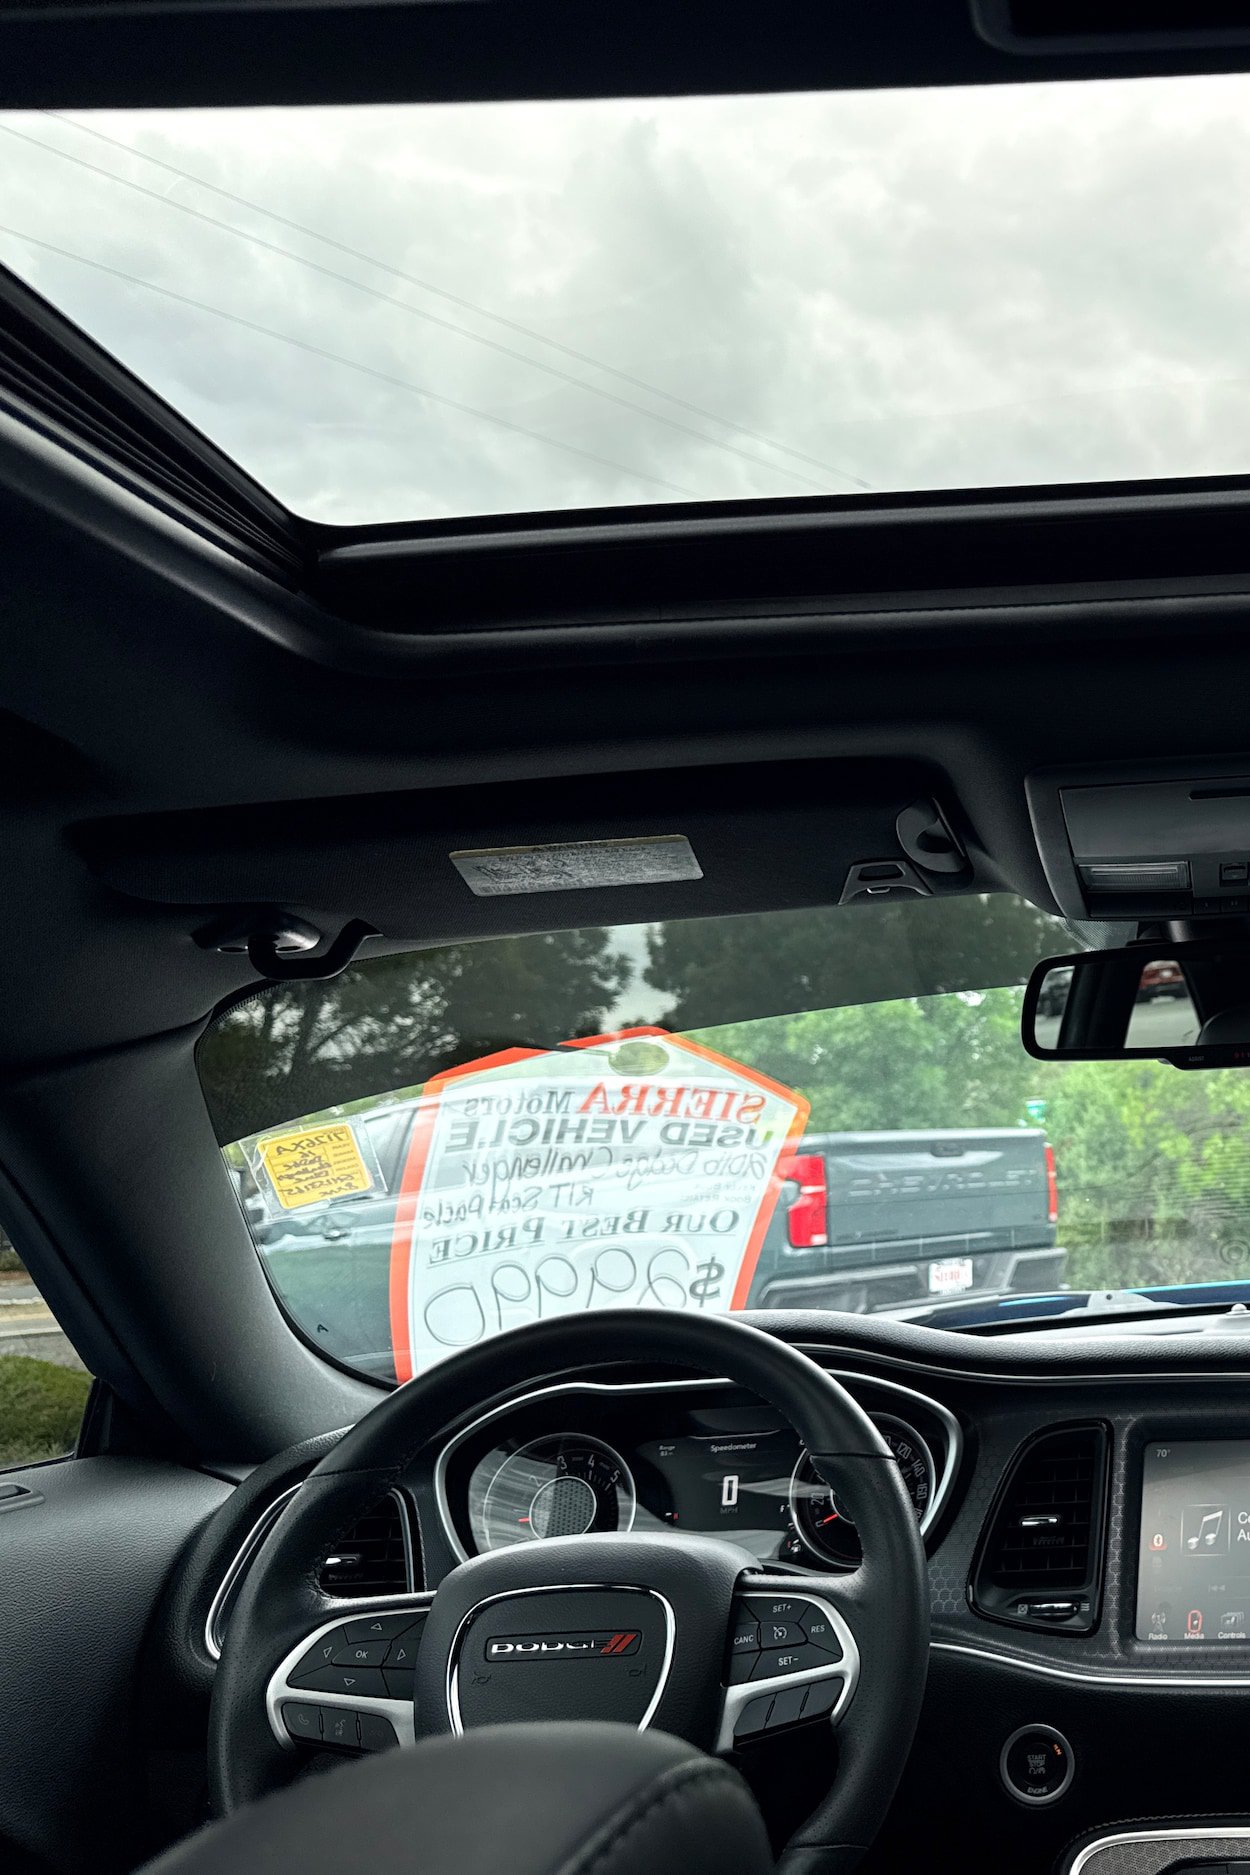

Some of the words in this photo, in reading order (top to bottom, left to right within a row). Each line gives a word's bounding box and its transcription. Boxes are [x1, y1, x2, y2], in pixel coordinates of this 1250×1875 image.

[710, 1443, 757, 1453] Speedometer
[897, 1442, 913, 1460] 120
[557, 1456, 568, 1470] 3
[587, 1454, 595, 1468] 4
[911, 1460, 926, 1477] 140
[609, 1470, 621, 1484] 5
[721, 1475, 739, 1506] 0
[810, 1624, 826, 1634] RES
[733, 1634, 754, 1645] CANC
[1148, 1632, 1168, 1640] Radio
[1184, 1632, 1205, 1640] Media
[1218, 1631, 1246, 1639] Controls
[355, 1650, 369, 1659] OK
